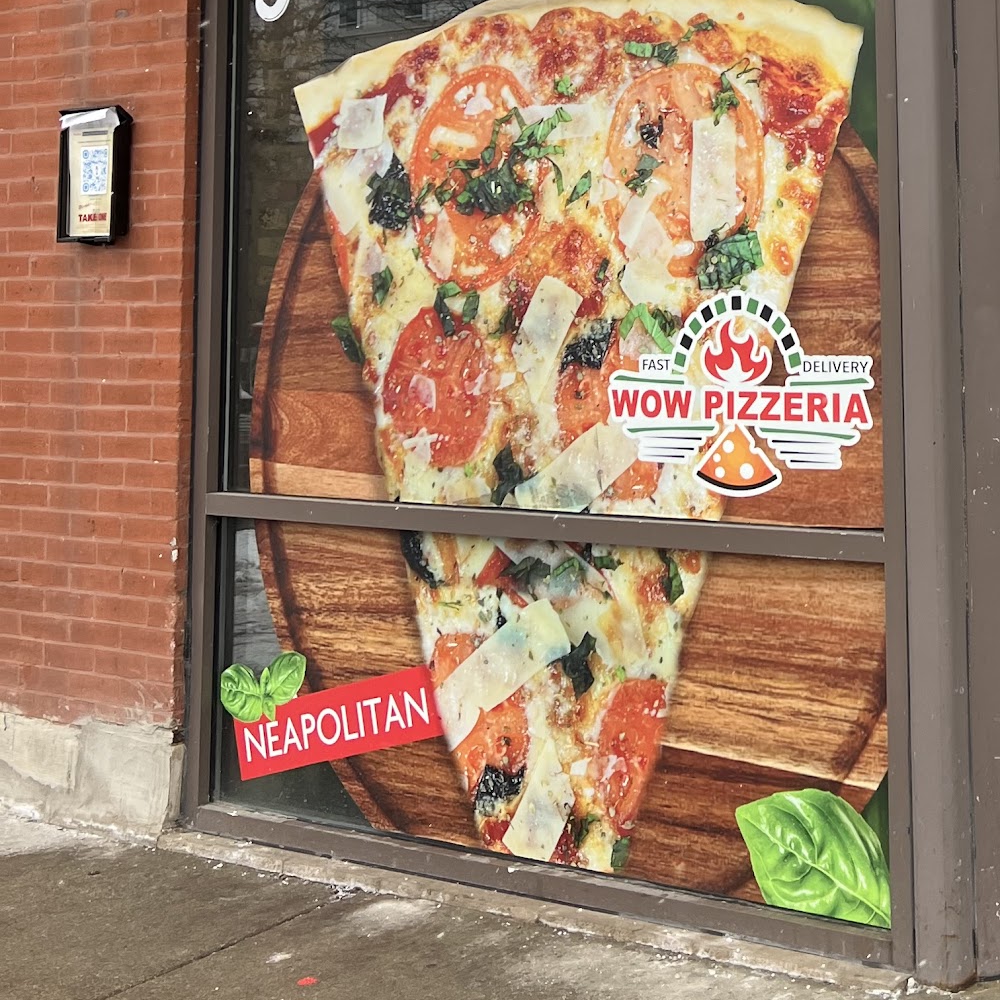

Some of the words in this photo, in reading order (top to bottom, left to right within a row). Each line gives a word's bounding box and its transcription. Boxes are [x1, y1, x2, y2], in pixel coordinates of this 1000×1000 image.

[642, 359, 670, 371] FAST
[803, 360, 869, 373] DELIVERY
[612, 389, 692, 418] WOW
[704, 390, 868, 423] PIZZERIA
[243, 687, 430, 762] NEAPOLITAN
